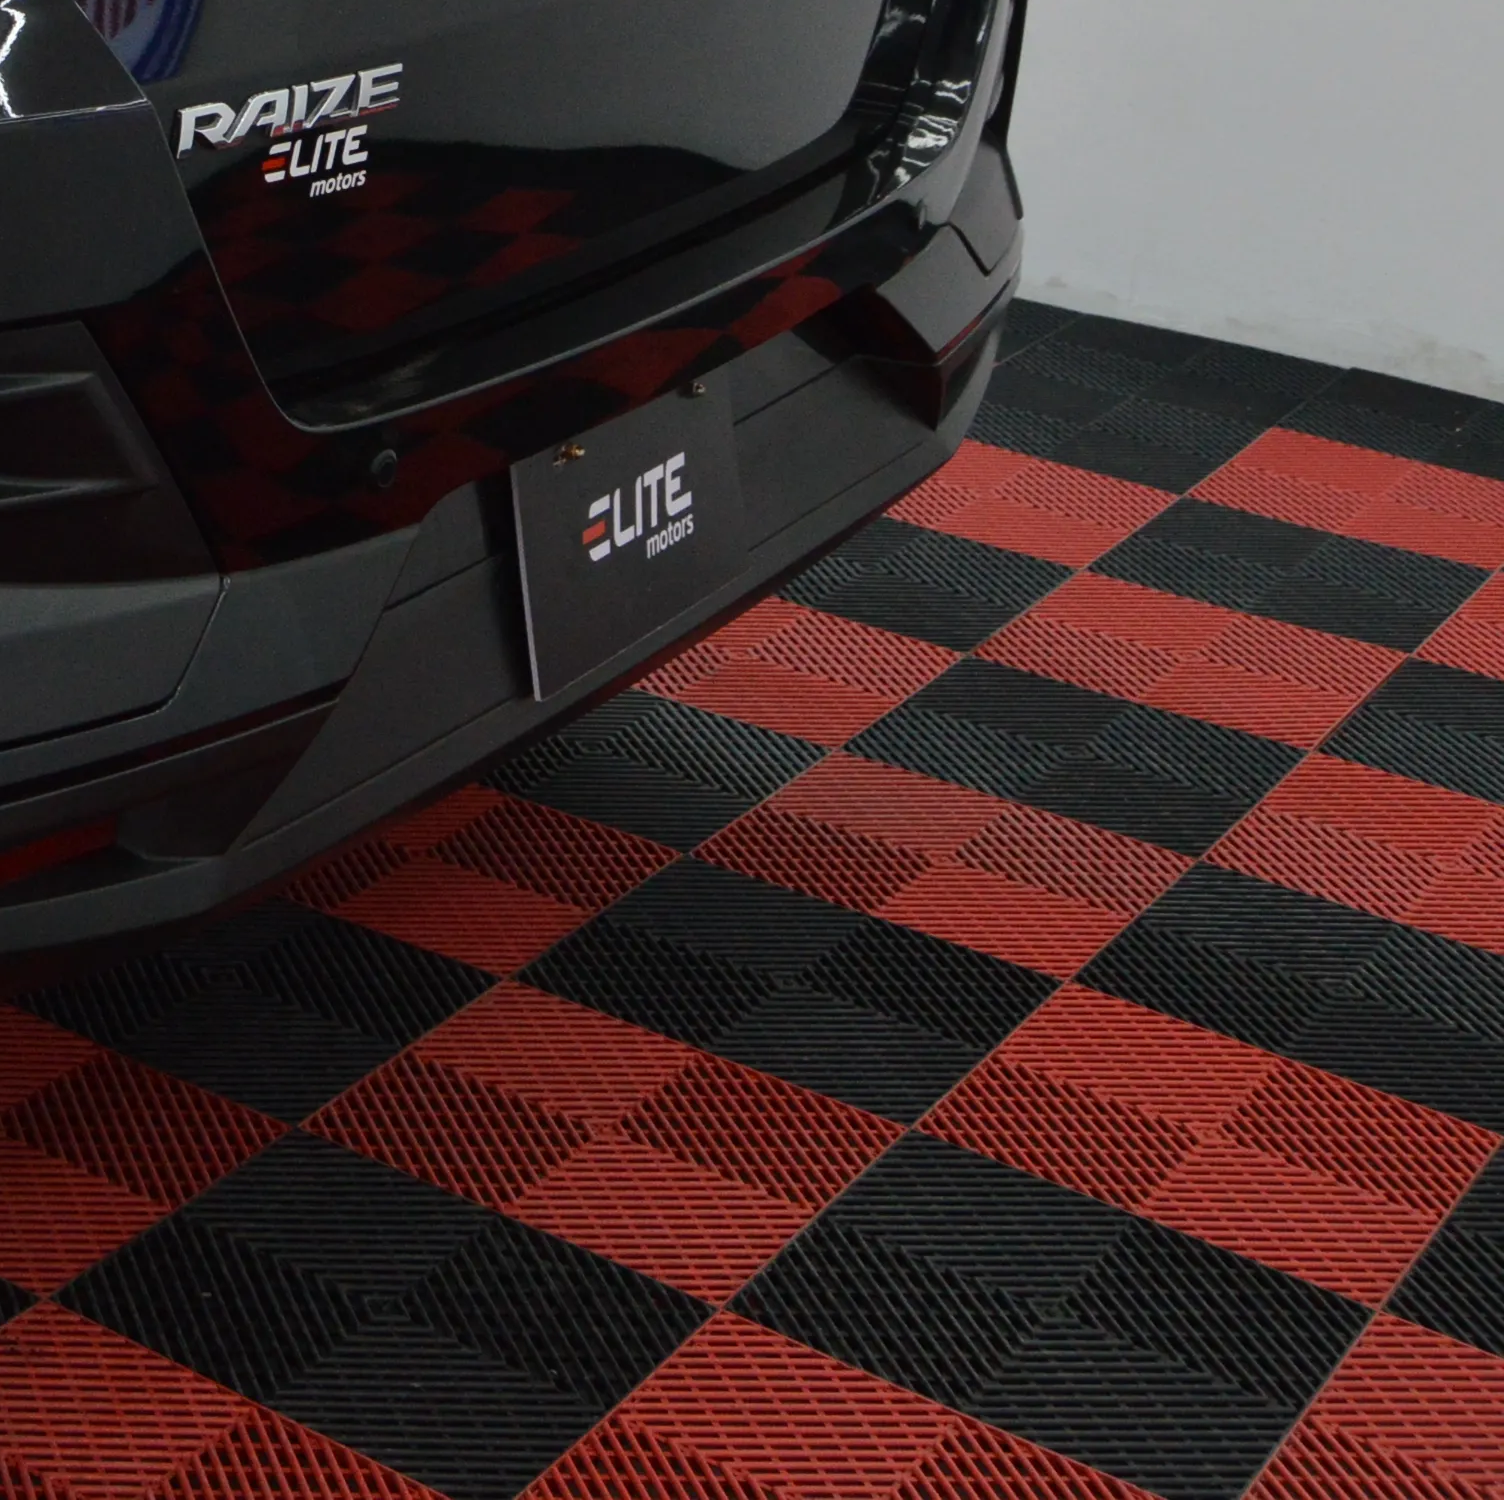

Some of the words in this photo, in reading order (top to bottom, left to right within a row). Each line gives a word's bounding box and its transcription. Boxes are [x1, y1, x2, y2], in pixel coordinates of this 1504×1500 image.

[176, 62, 404, 159] RAIZE
[262, 124, 369, 184] ELITE
[309, 169, 367, 198] motors
[582, 451, 693, 562] ELITE
[646, 513, 695, 559] motors
